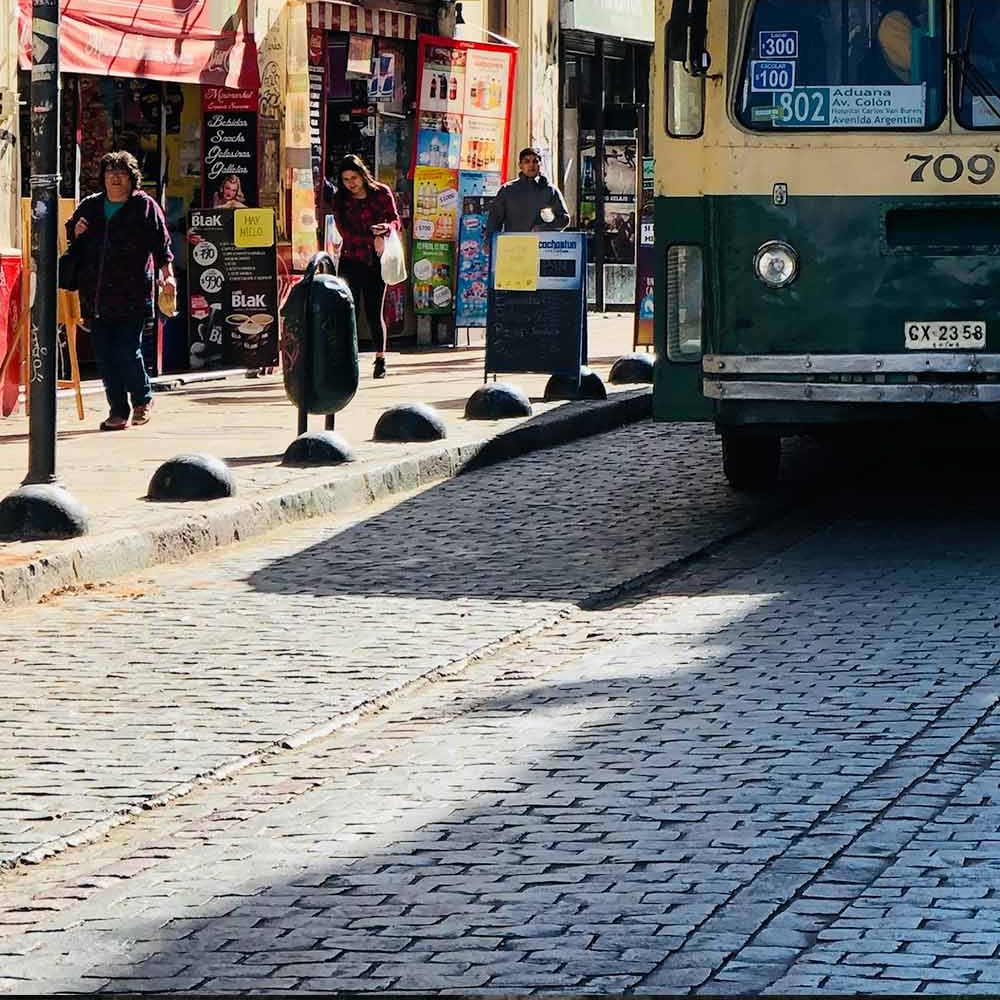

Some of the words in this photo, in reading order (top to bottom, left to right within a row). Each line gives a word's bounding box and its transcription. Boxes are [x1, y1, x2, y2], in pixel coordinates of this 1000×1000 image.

[833, 88, 891, 97] Aduana
[780, 92, 824, 121] 802
[832, 98, 850, 107] Av.
[855, 97, 891, 107] Colón
[208, 114, 248, 127] Bebidas
[832, 115, 871, 124] Avenida
[874, 115, 922, 127] Argentina
[210, 129, 245, 143] Snacks
[904, 153, 996, 185] 709
[939, 325, 983, 341] 2358
